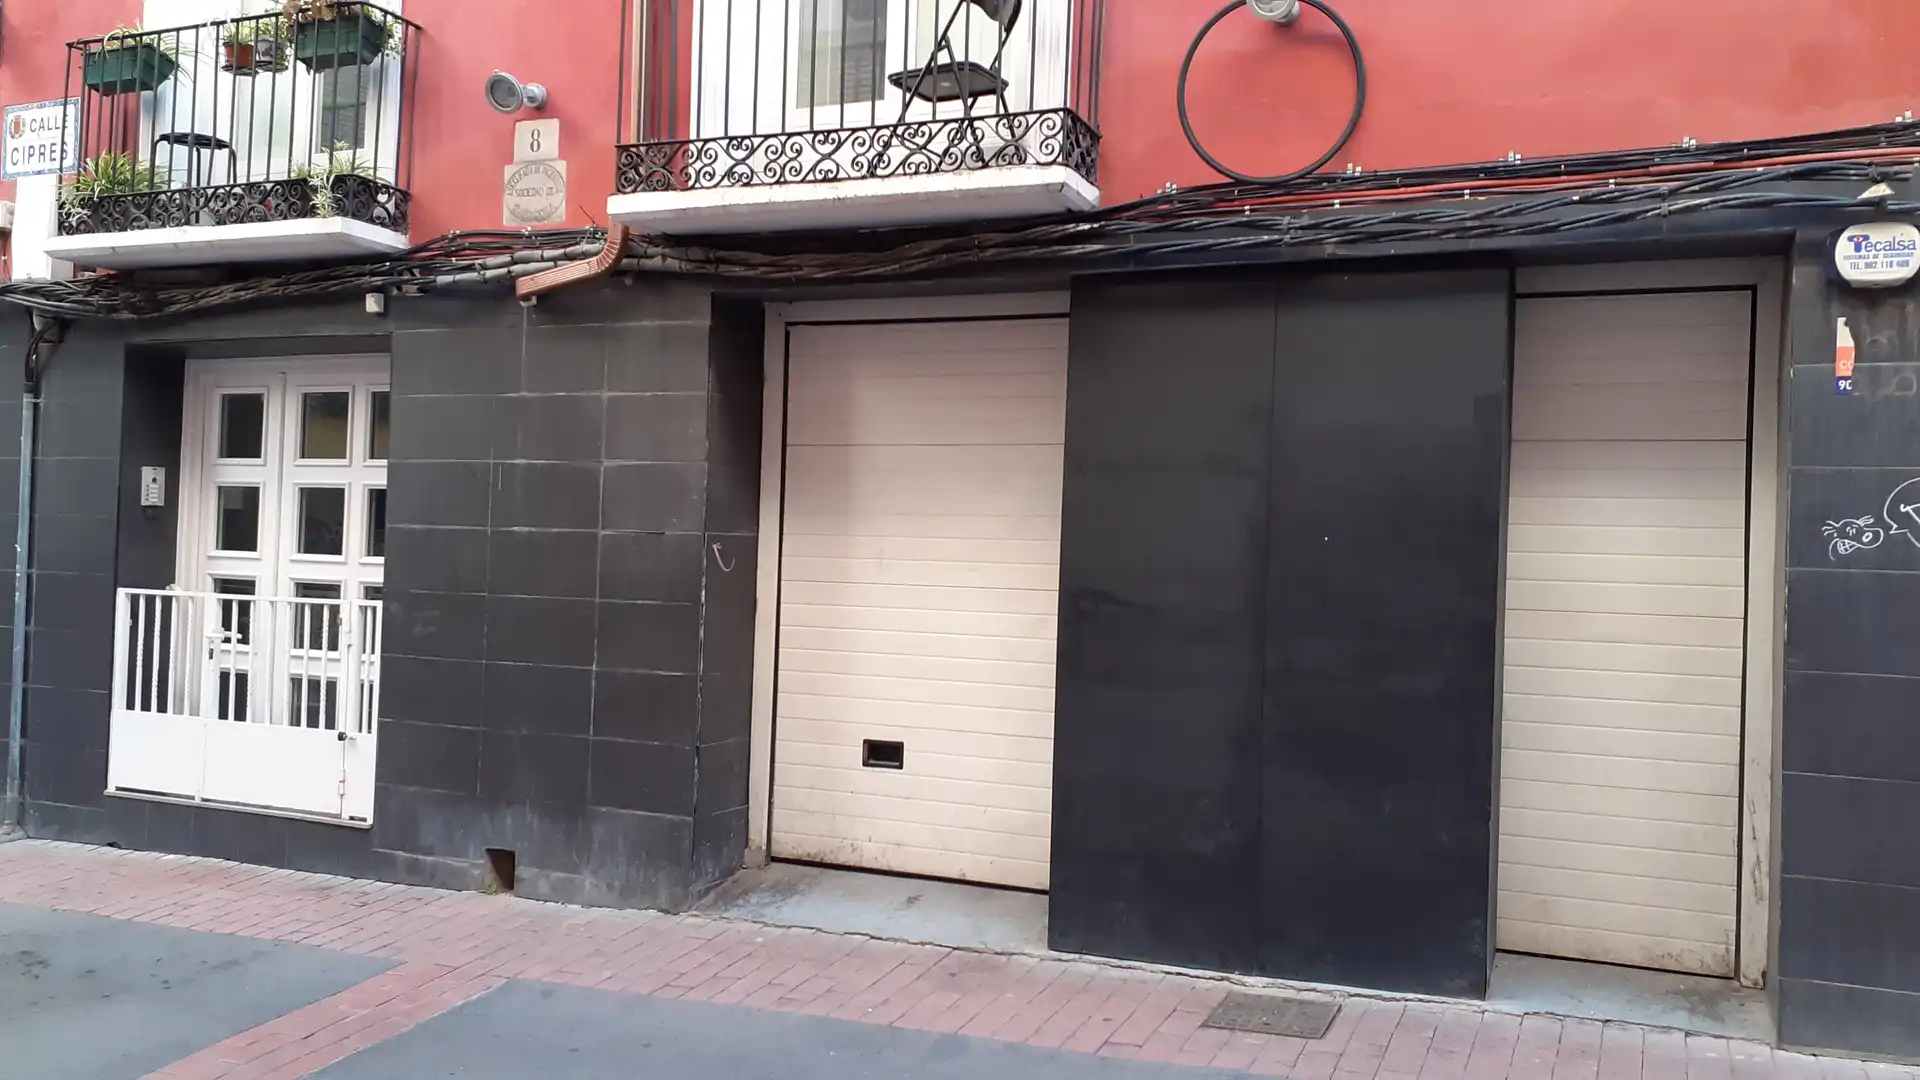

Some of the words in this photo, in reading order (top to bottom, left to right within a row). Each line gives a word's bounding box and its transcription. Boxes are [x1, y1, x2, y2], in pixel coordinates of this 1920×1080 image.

[530, 128, 541, 153] 8
[11, 141, 68, 166] CIPRES
[1847, 234, 1917, 253] Tecalsa
